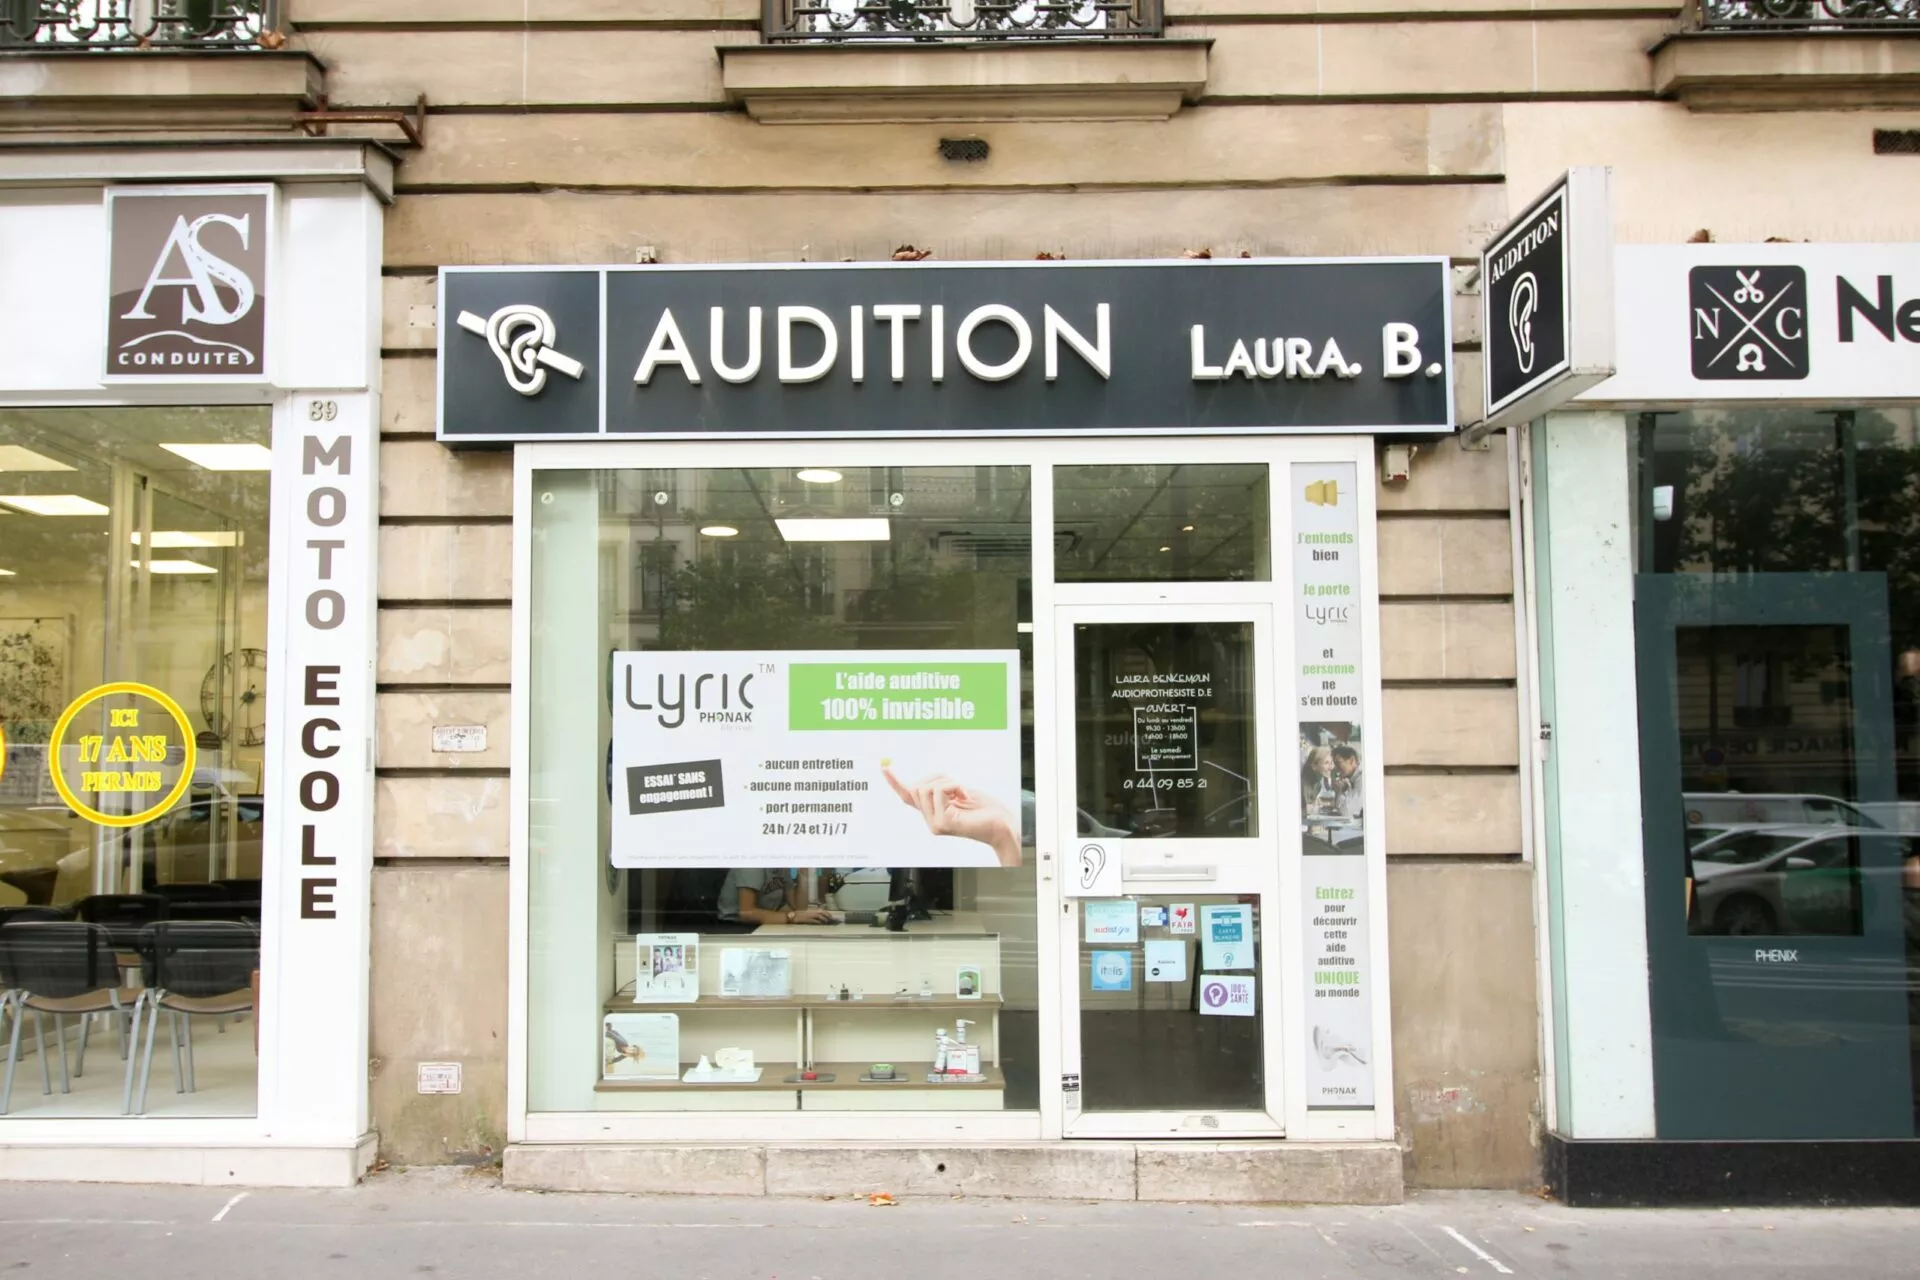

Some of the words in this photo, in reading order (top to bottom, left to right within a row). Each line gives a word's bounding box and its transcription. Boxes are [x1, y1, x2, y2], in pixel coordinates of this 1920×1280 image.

[1490, 210, 1560, 285] AUDITION
[120, 213, 255, 325] AS
[1694, 307, 1721, 339] N
[1775, 307, 1802, 339] C
[633, 302, 1112, 387] AUDITION
[1382, 322, 1443, 379] B.
[118, 351, 240, 365] CONDUITE
[309, 400, 338, 421] 89
[302, 435, 352, 630] MOTO
[1297, 532, 1354, 544] J'entends
[1312, 549, 1339, 561] bien
[1303, 583, 1315, 595] Je
[1317, 583, 1350, 596] porte
[1305, 604, 1348, 625] Lyric
[1322, 648, 1334, 659] et
[1302, 664, 1355, 676] personne
[835, 671, 885, 689] L'aide
[889, 671, 960, 689] auditive
[1115, 675, 1150, 684] LAURA
[1321, 680, 1336, 690] ne
[626, 664, 754, 728] Lyric
[1301, 695, 1323, 706] s'en
[1326, 695, 1358, 706] doute
[821, 697, 878, 720] 100%
[882, 697, 976, 720] invisible
[1146, 703, 1186, 713] OUVERT
[110, 709, 138, 727] ICI
[700, 712, 752, 723] PHONAK
[79, 735, 104, 763] 17
[106, 735, 167, 762] ANS
[1159, 745, 1182, 753] samedi
[765, 760, 799, 770] aucun
[802, 758, 853, 770] entretien
[81, 771, 163, 792] PERMIS
[678, 770, 706, 785] SANS
[750, 781, 791, 791] aucune
[794, 779, 869, 793] manipulation
[1123, 779, 1133, 789] 01
[1136, 778, 1153, 789] 44
[1157, 778, 1173, 790] 09
[1177, 778, 1194, 789] 85
[299, 665, 341, 919] ECOLE
[639, 787, 707, 804] engagement
[766, 802, 788, 814] port
[791, 802, 853, 814] permanent
[793, 823, 806, 835] 24
[808, 823, 820, 835] et
[1315, 886, 1355, 899] Entrez
[1324, 903, 1346, 914] pour
[1171, 921, 1193, 929] FAIR
[1313, 916, 1358, 926] découvrir
[1324, 929, 1348, 939] cette
[1326, 942, 1346, 953] aide
[1318, 956, 1355, 966] auditive
[1755, 949, 1798, 963] PHENIX
[1314, 971, 1360, 985] UNIQUE
[1314, 988, 1326, 998] au
[1327, 988, 1360, 998] monde
[1322, 1086, 1357, 1095] PHONAK
